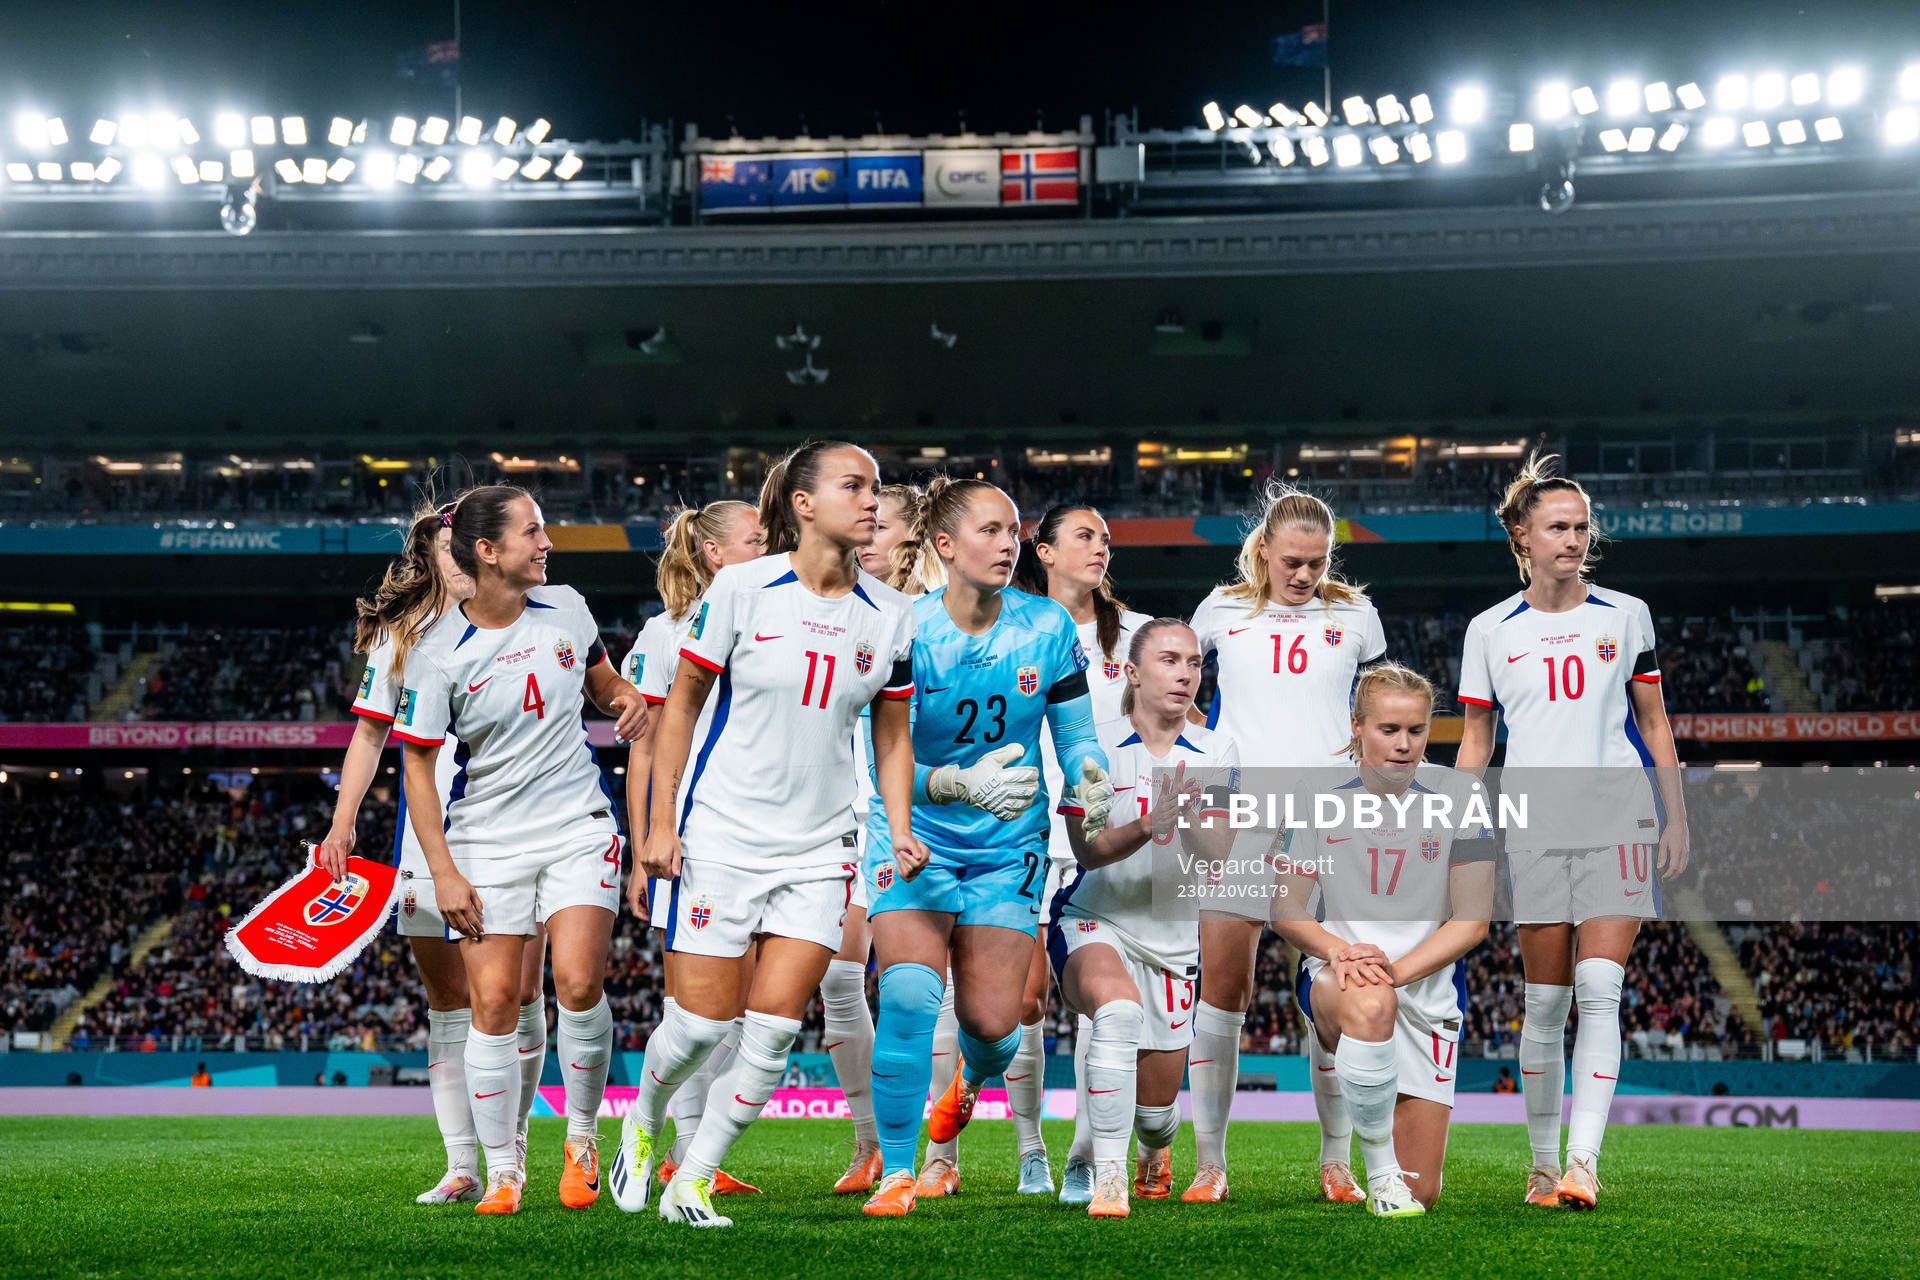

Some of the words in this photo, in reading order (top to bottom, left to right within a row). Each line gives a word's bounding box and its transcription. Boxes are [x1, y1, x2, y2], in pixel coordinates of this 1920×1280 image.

[857, 169, 910, 189] FIFA
[948, 171, 987, 184] OFC
[160, 531, 281, 549] #FIFAWWC
[1270, 634, 1308, 674] 16
[523, 672, 545, 720] 4
[801, 650, 836, 710] 11
[1543, 654, 1585, 701] 10
[89, 727, 180, 744] BEYOND
[184, 727, 317, 744] GREATNESS
[953, 694, 1007, 744] 23
[1674, 719, 1786, 738] WOMEN'S
[1795, 718, 1885, 737] WORLD
[603, 834, 620, 877] 4
[1367, 847, 1407, 896] 17
[1617, 843, 1648, 883] 10
[1160, 967, 1193, 1012] 13
[758, 1099, 807, 1118] RLD
[807, 1099, 854, 1118] CUP
